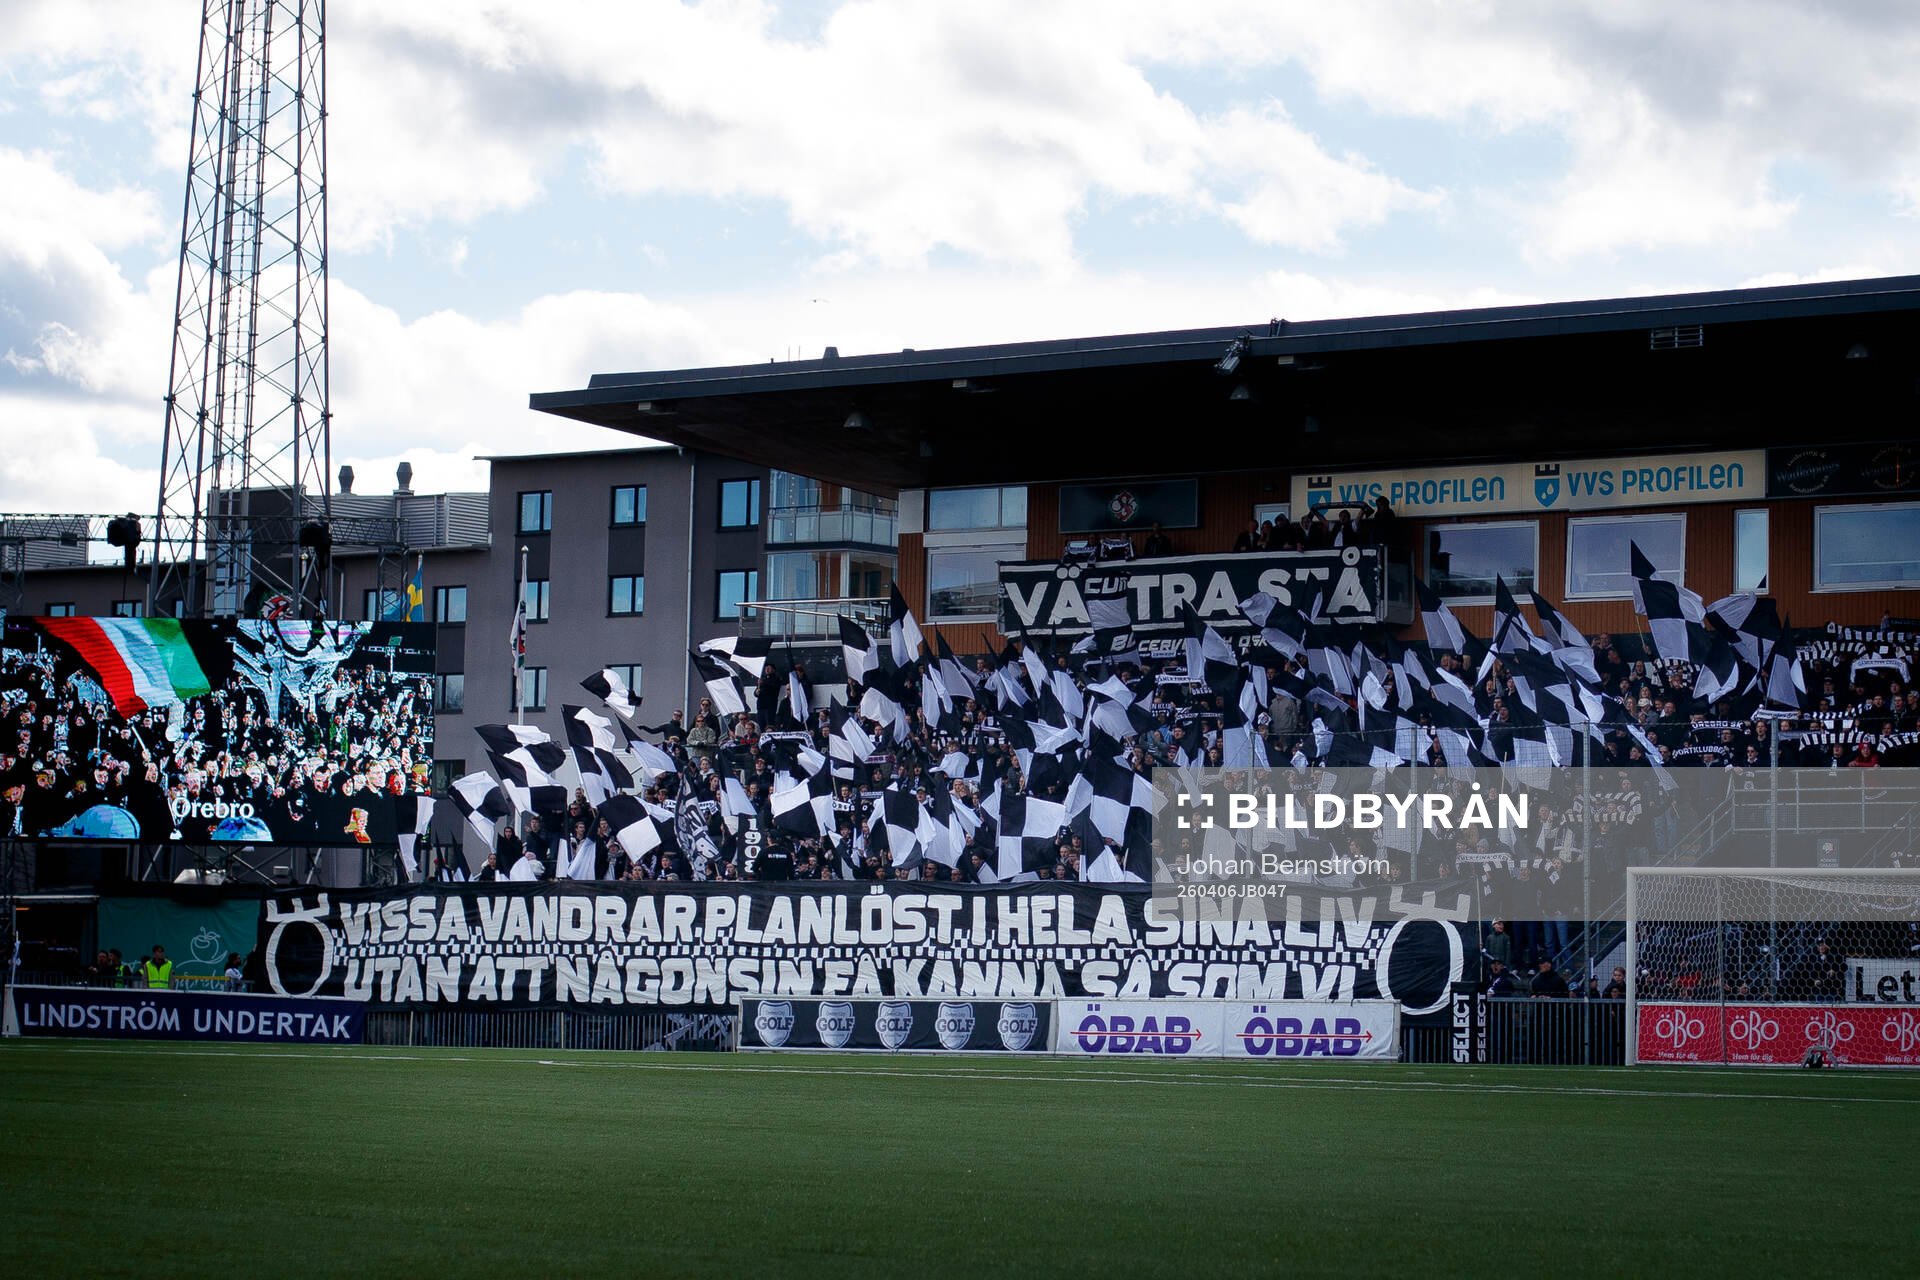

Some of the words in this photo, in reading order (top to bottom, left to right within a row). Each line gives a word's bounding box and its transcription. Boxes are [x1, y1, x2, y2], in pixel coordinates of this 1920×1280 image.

[1338, 482, 1382, 507] VVS
[1567, 470, 1614, 496] VVS
[1004, 564, 1240, 626] VÄTRA
[340, 895, 470, 945] VISSA
[476, 895, 697, 944] VANDRAR
[705, 885, 963, 945] PLANLÖST
[997, 895, 1132, 946] HELA
[1143, 895, 1273, 946] SINA
[1284, 895, 1378, 948] LIV
[344, 955, 462, 1003] UTAN
[467, 955, 549, 1001] ATT
[556, 948, 813, 1005] NÅGONSIN
[1081, 953, 1151, 1000] SÅ
[1167, 960, 1288, 1000] SOM
[1299, 963, 1357, 1000] VI
[23, 1000, 181, 1032] LINDSTRÖM
[193, 1008, 351, 1039] UNDERTAK
[756, 1016, 793, 1031] GOLF
[817, 1017, 854, 1032] GOLF
[877, 1017, 913, 1032] GOLF
[936, 1018, 974, 1033] GOLF
[998, 1019, 1036, 1034] GOLF
[1077, 1004, 1192, 1055] ÖBAB
[1243, 1006, 1363, 1056] ÖBAB
[1453, 992, 1470, 1063] SELECT
[1655, 1009, 1705, 1049] ÖBO
[1729, 1010, 1780, 1050] ÖBO
[1804, 1011, 1855, 1051] ÖBO
